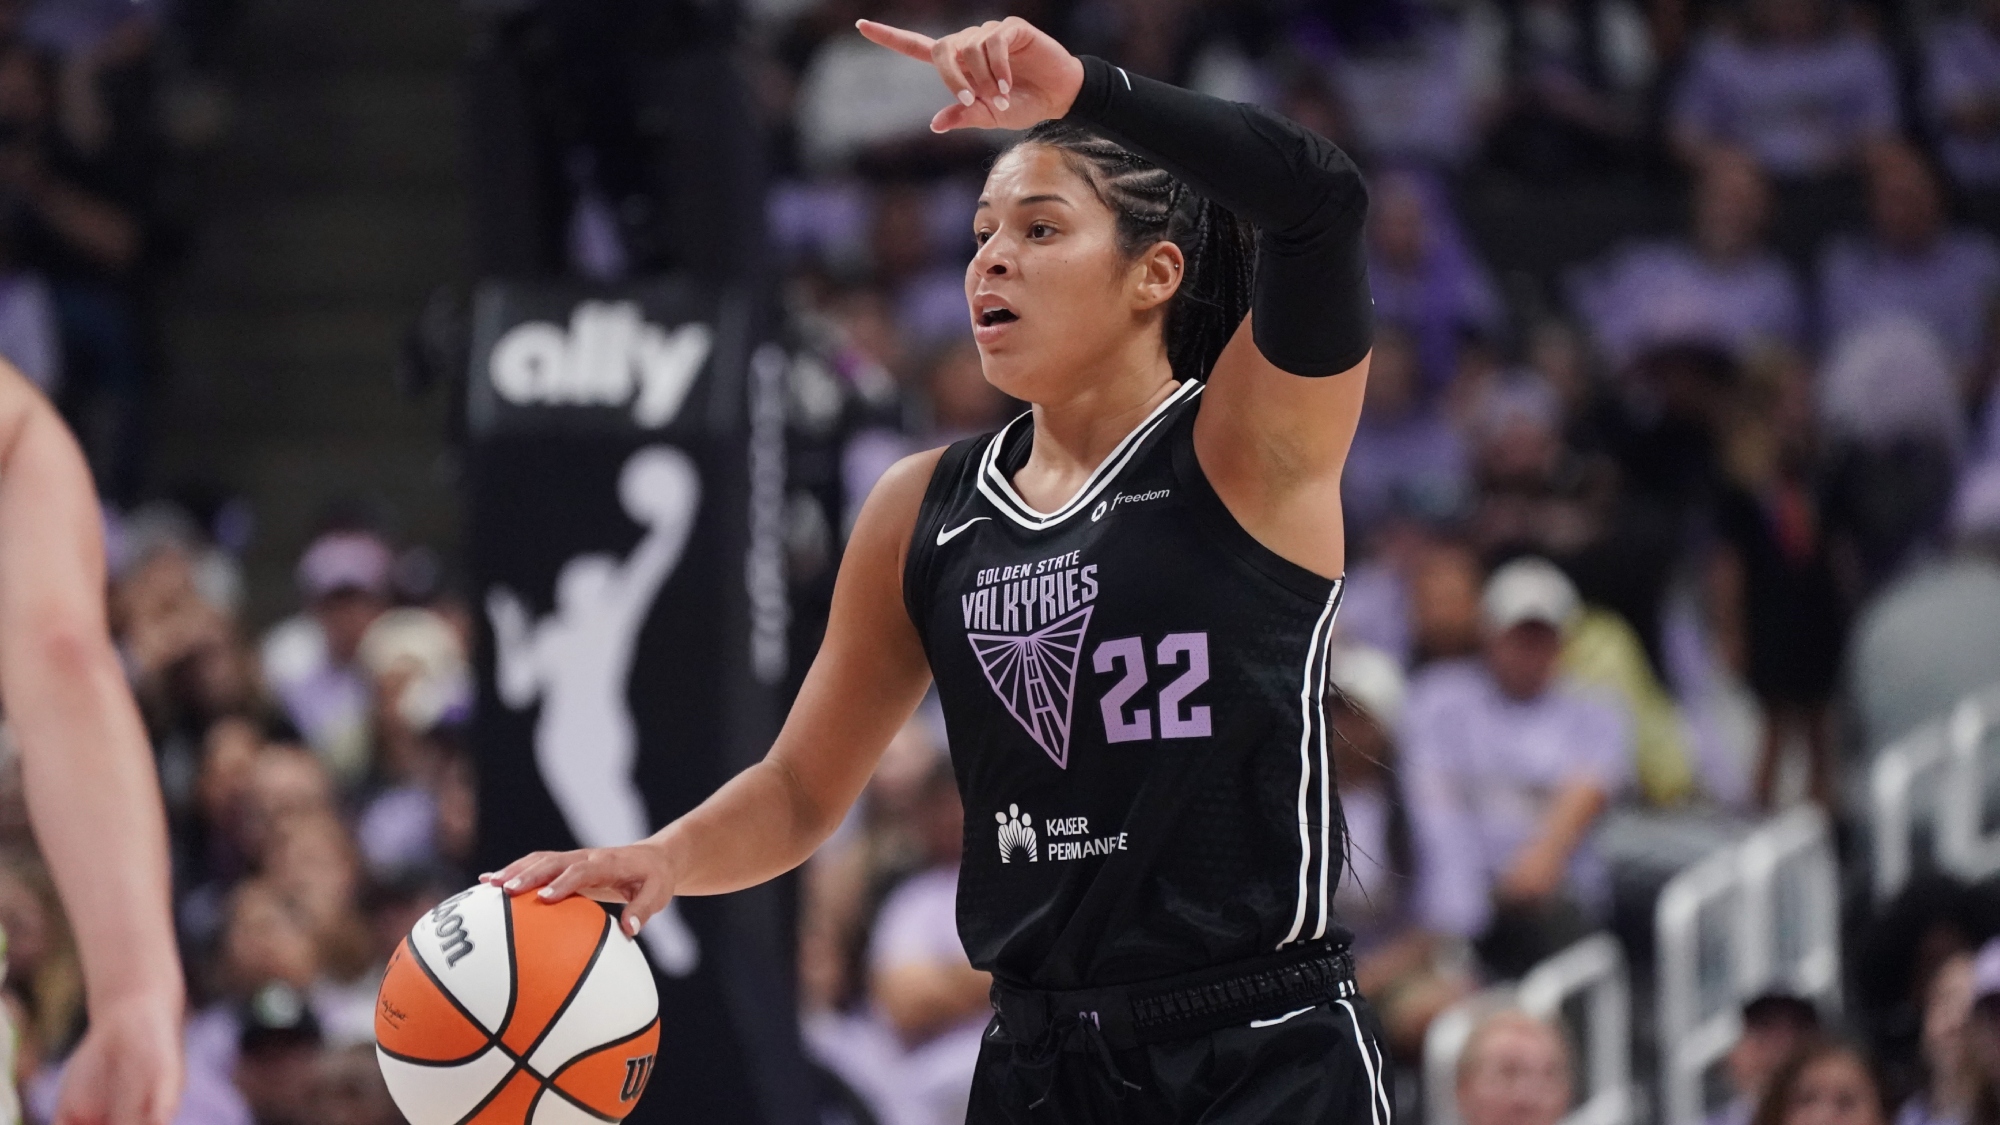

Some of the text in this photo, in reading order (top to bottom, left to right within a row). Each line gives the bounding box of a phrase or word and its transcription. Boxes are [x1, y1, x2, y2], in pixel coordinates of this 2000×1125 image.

[491, 302, 711, 426] ally
[1111, 489, 1170, 511] freedom
[977, 550, 1080, 587] GOLDEN STATE
[962, 564, 1098, 632] VALKYRIES
[1092, 632, 1212, 744] 22
[1046, 816, 1089, 836] KAISER
